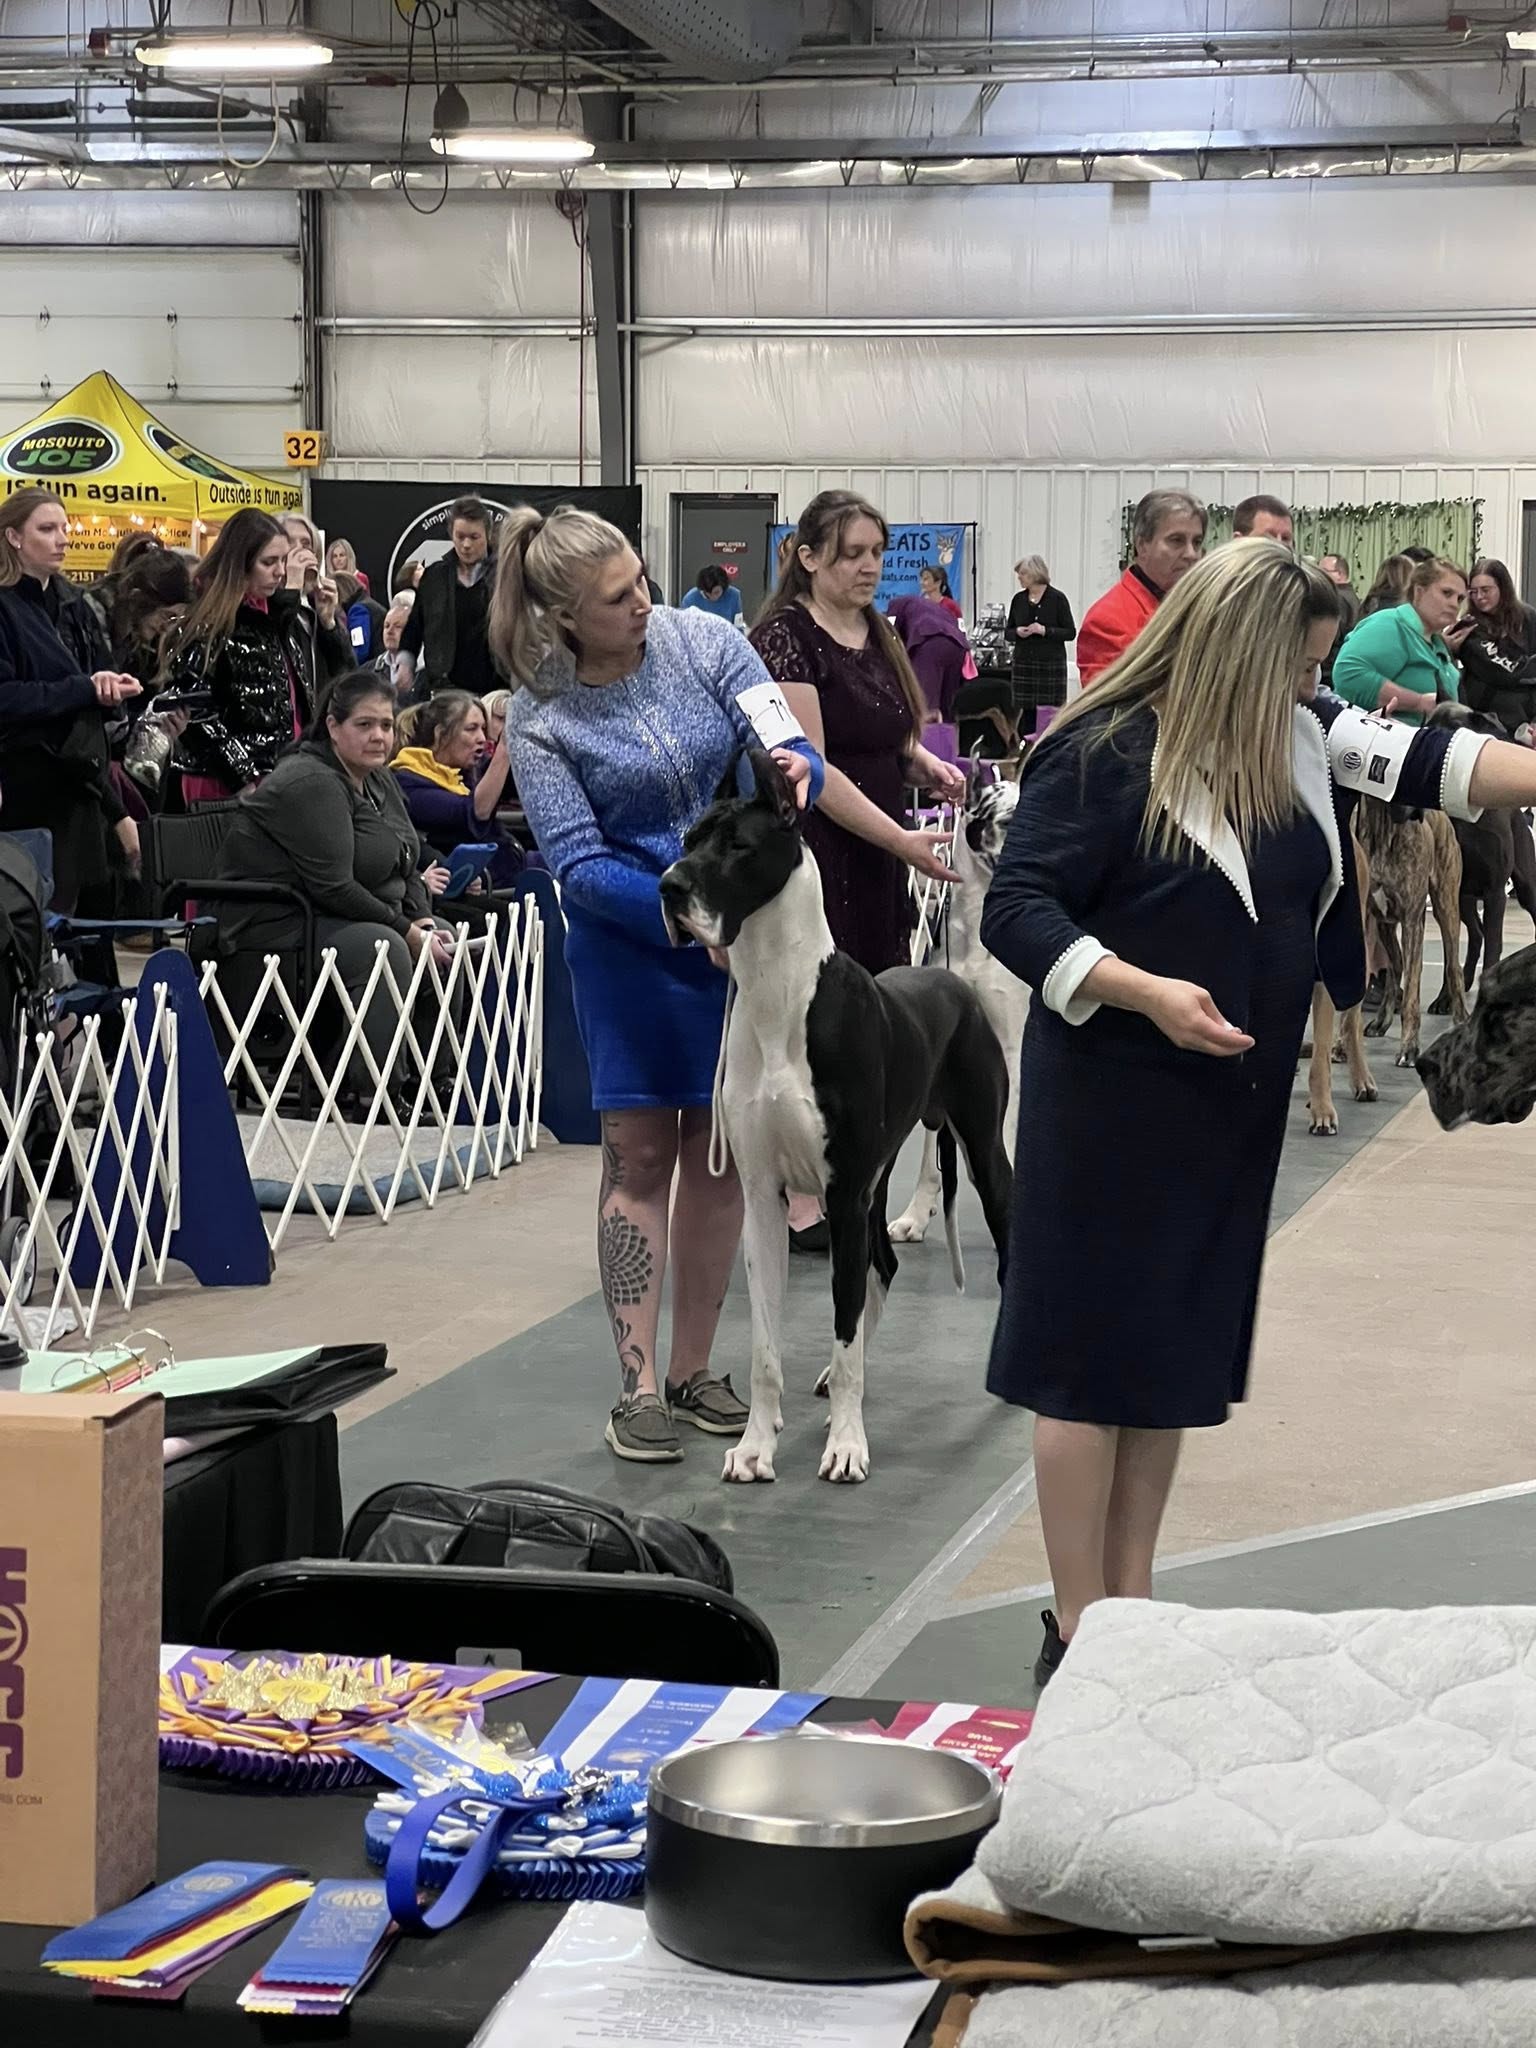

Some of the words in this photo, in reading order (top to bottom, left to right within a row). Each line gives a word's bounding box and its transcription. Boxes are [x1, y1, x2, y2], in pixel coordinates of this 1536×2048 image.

[22, 436, 105, 450] MOSQUITO
[287, 437, 317, 459] 32
[17, 450, 96, 468] JOE
[87, 482, 167, 504] again.
[209, 483, 251, 504] Outside
[254, 487, 262, 504] is
[98, 540, 116, 550] Got
[897, 556, 929, 568] Fresh
[969, 1743, 1004, 1753] GREAT
